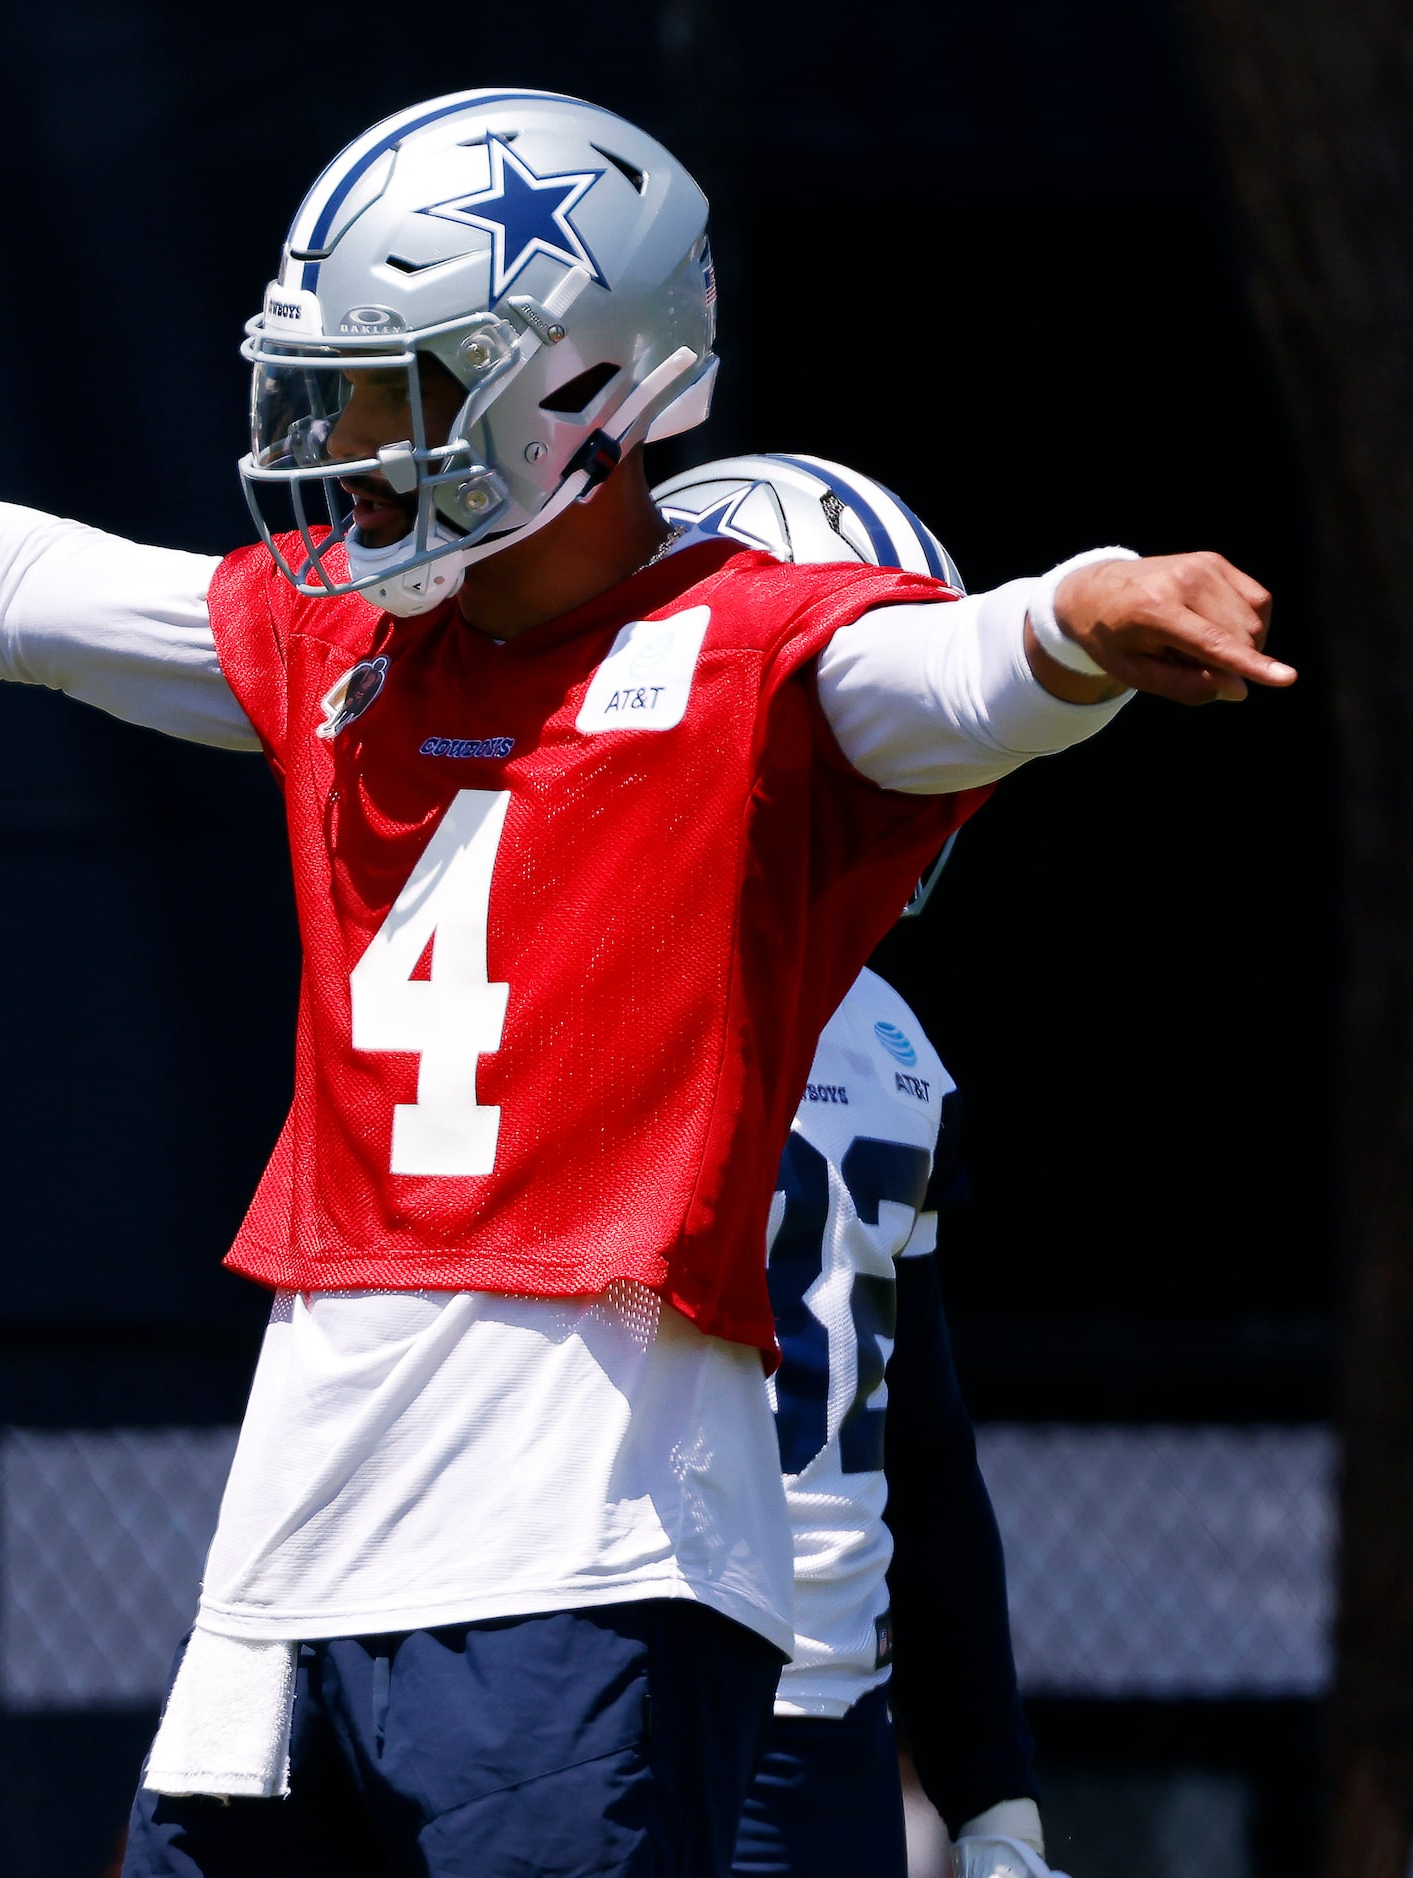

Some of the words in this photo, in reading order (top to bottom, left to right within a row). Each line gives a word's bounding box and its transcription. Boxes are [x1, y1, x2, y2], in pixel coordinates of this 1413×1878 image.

[340, 324, 401, 334] OAKLEY
[604, 687, 665, 714] AT&T
[419, 736, 515, 758] COWBOYS
[350, 788, 511, 1175] 4
[802, 1083, 849, 1105] BOYS
[895, 1071, 930, 1104] AT&T
